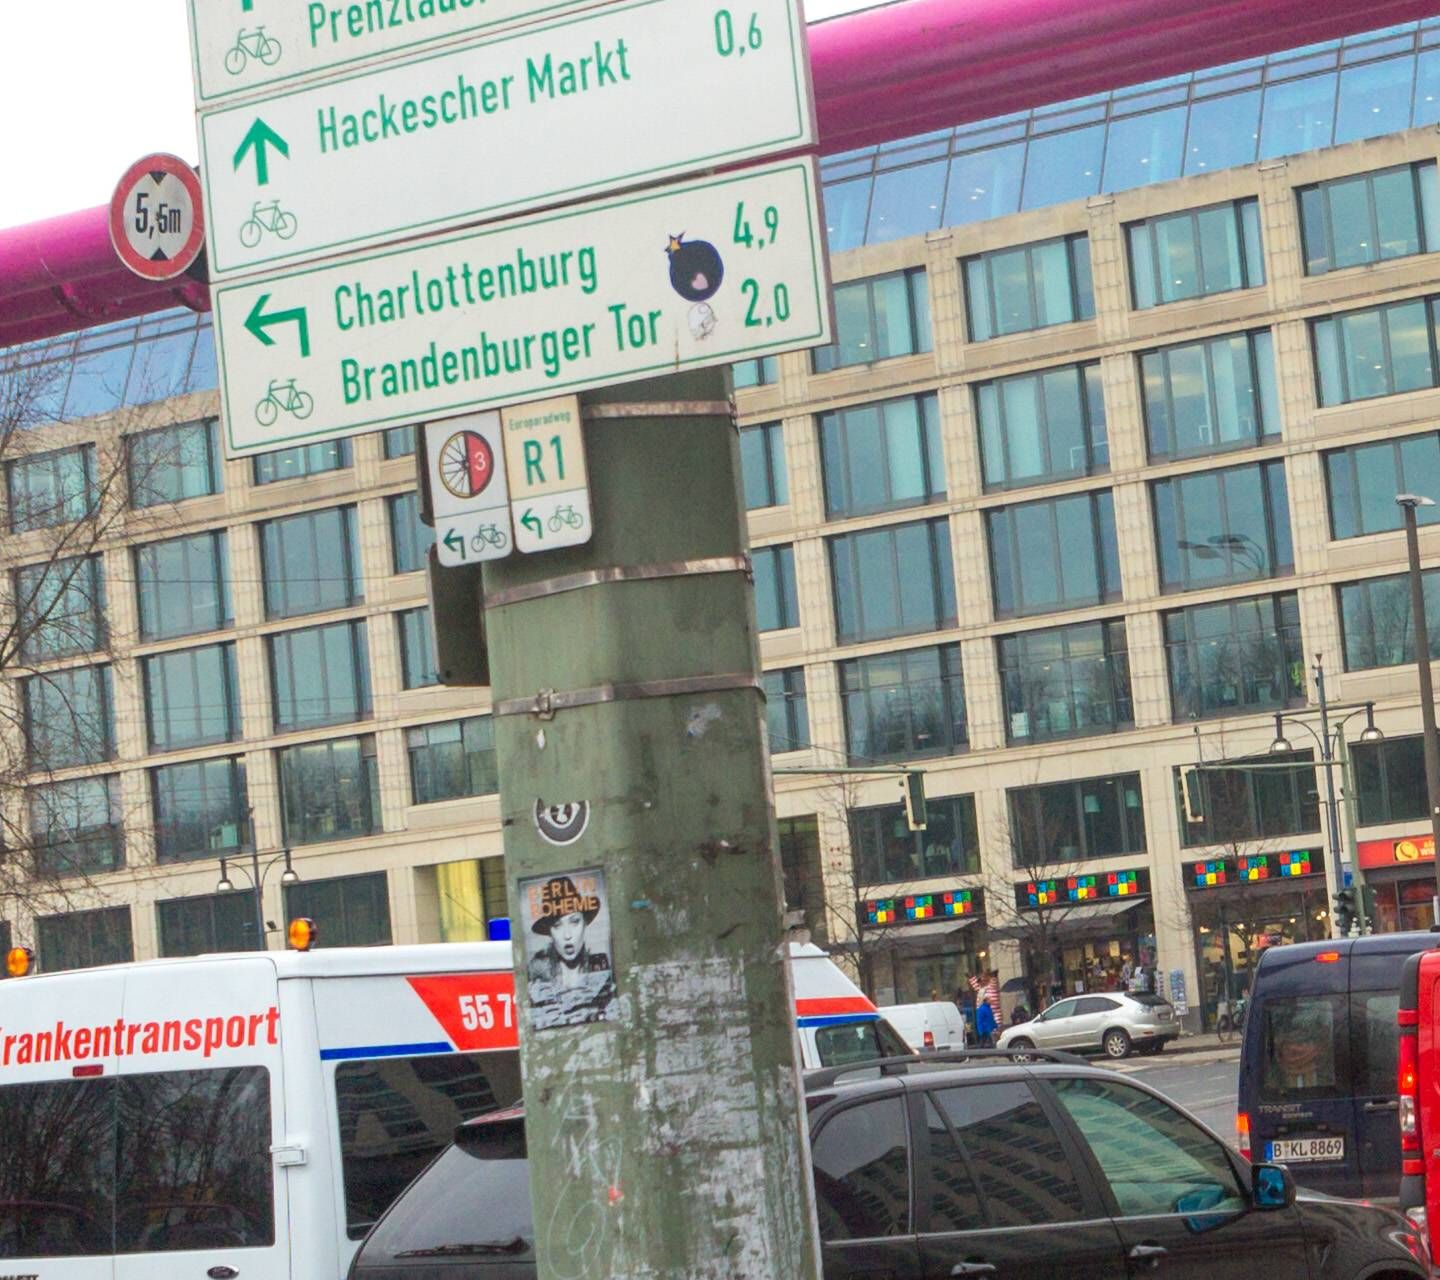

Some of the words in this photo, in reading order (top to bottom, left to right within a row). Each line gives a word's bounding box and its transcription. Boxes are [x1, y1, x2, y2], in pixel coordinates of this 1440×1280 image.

[713, 9, 763, 57] 0,6
[317, 74, 515, 154] Hackescher
[526, 38, 631, 104] Markt
[732, 201, 779, 251] 4,9
[333, 246, 598, 332] Charlottenburg
[741, 278, 791, 328] 2,0
[341, 321, 596, 405] Brandenburger
[608, 303, 662, 351] Tor
[474, 451, 486, 471] 3
[527, 876, 598, 904] BERLIN
[530, 896, 599, 921] BOHEME
[458, 993, 495, 1032] 55
[1273, 1143, 1282, 1158] B
[1290, 1141, 1308, 1157] KL
[1310, 1139, 1341, 1156] 8869
